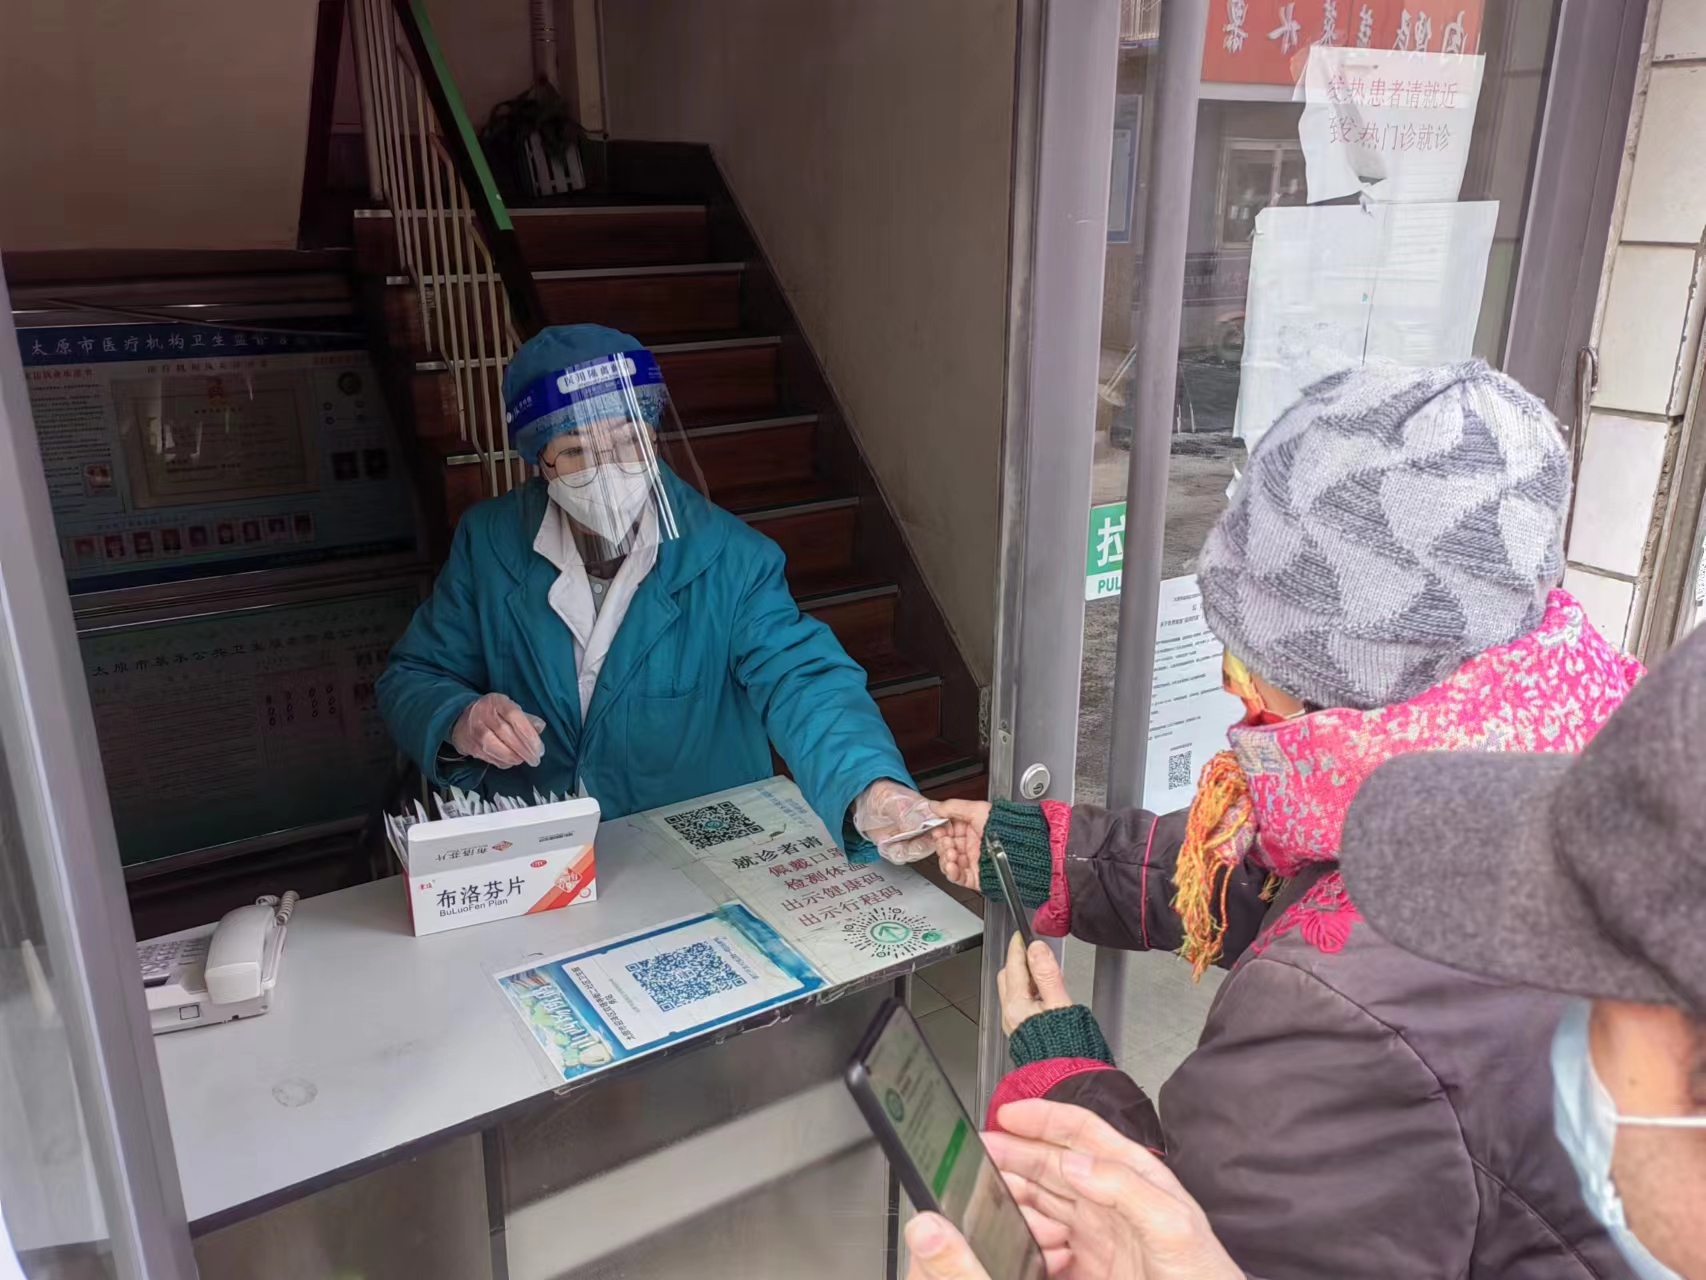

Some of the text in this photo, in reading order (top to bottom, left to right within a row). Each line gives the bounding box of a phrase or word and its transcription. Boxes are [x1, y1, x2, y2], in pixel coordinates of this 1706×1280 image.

[1330, 116, 1451, 151] 到发热门诊就诊
[1099, 578, 1122, 594] PUL
[732, 835, 824, 870] 就诊者请
[437, 876, 526, 909] 布洛芬片
[782, 871, 886, 912] 出示健康码
[784, 862, 869, 891] 检测体温
[439, 898, 509, 917] BuLuoFen Pian
[798, 885, 903, 927] 出示行程码
[532, 983, 600, 1048] 山西场所码
